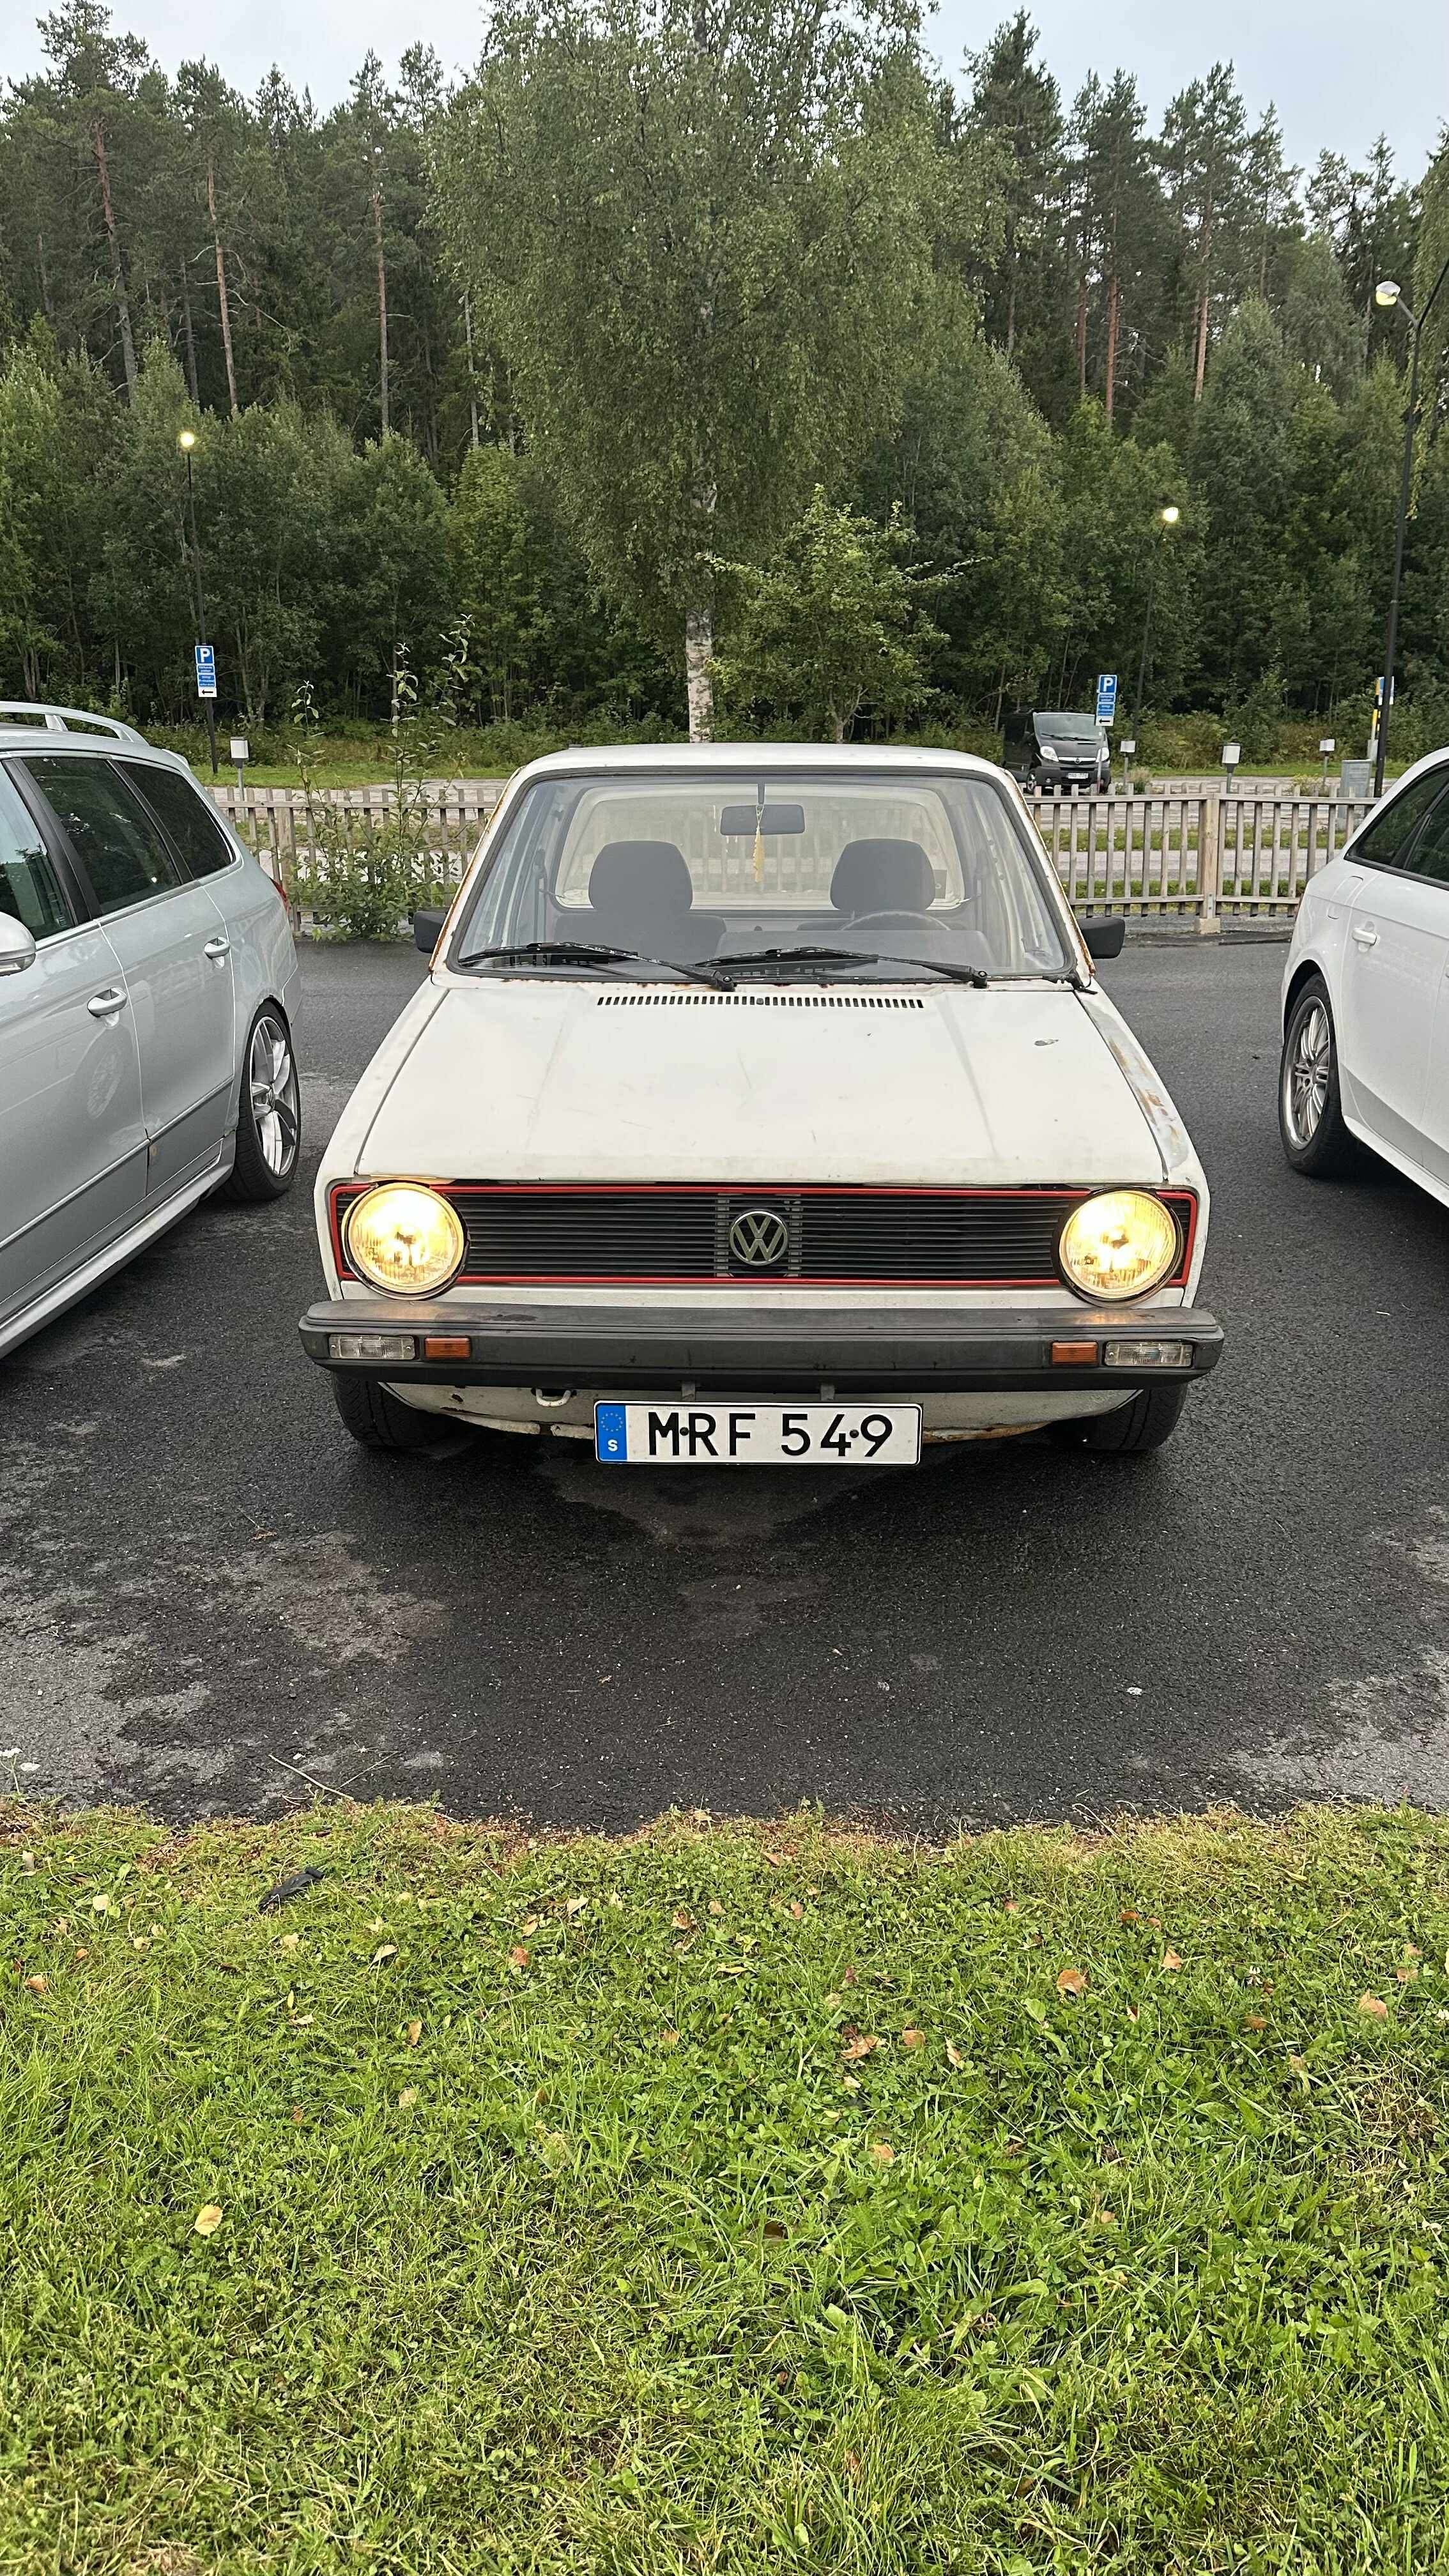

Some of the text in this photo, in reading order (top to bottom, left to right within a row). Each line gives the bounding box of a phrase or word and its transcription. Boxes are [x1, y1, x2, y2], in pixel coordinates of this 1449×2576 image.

[200, 648, 210, 663] P
[1103, 677, 1114, 692] P
[733, 1214, 785, 1263] VW
[648, 1411, 893, 1457] MRF 549
[607, 1439, 618, 1453] S
